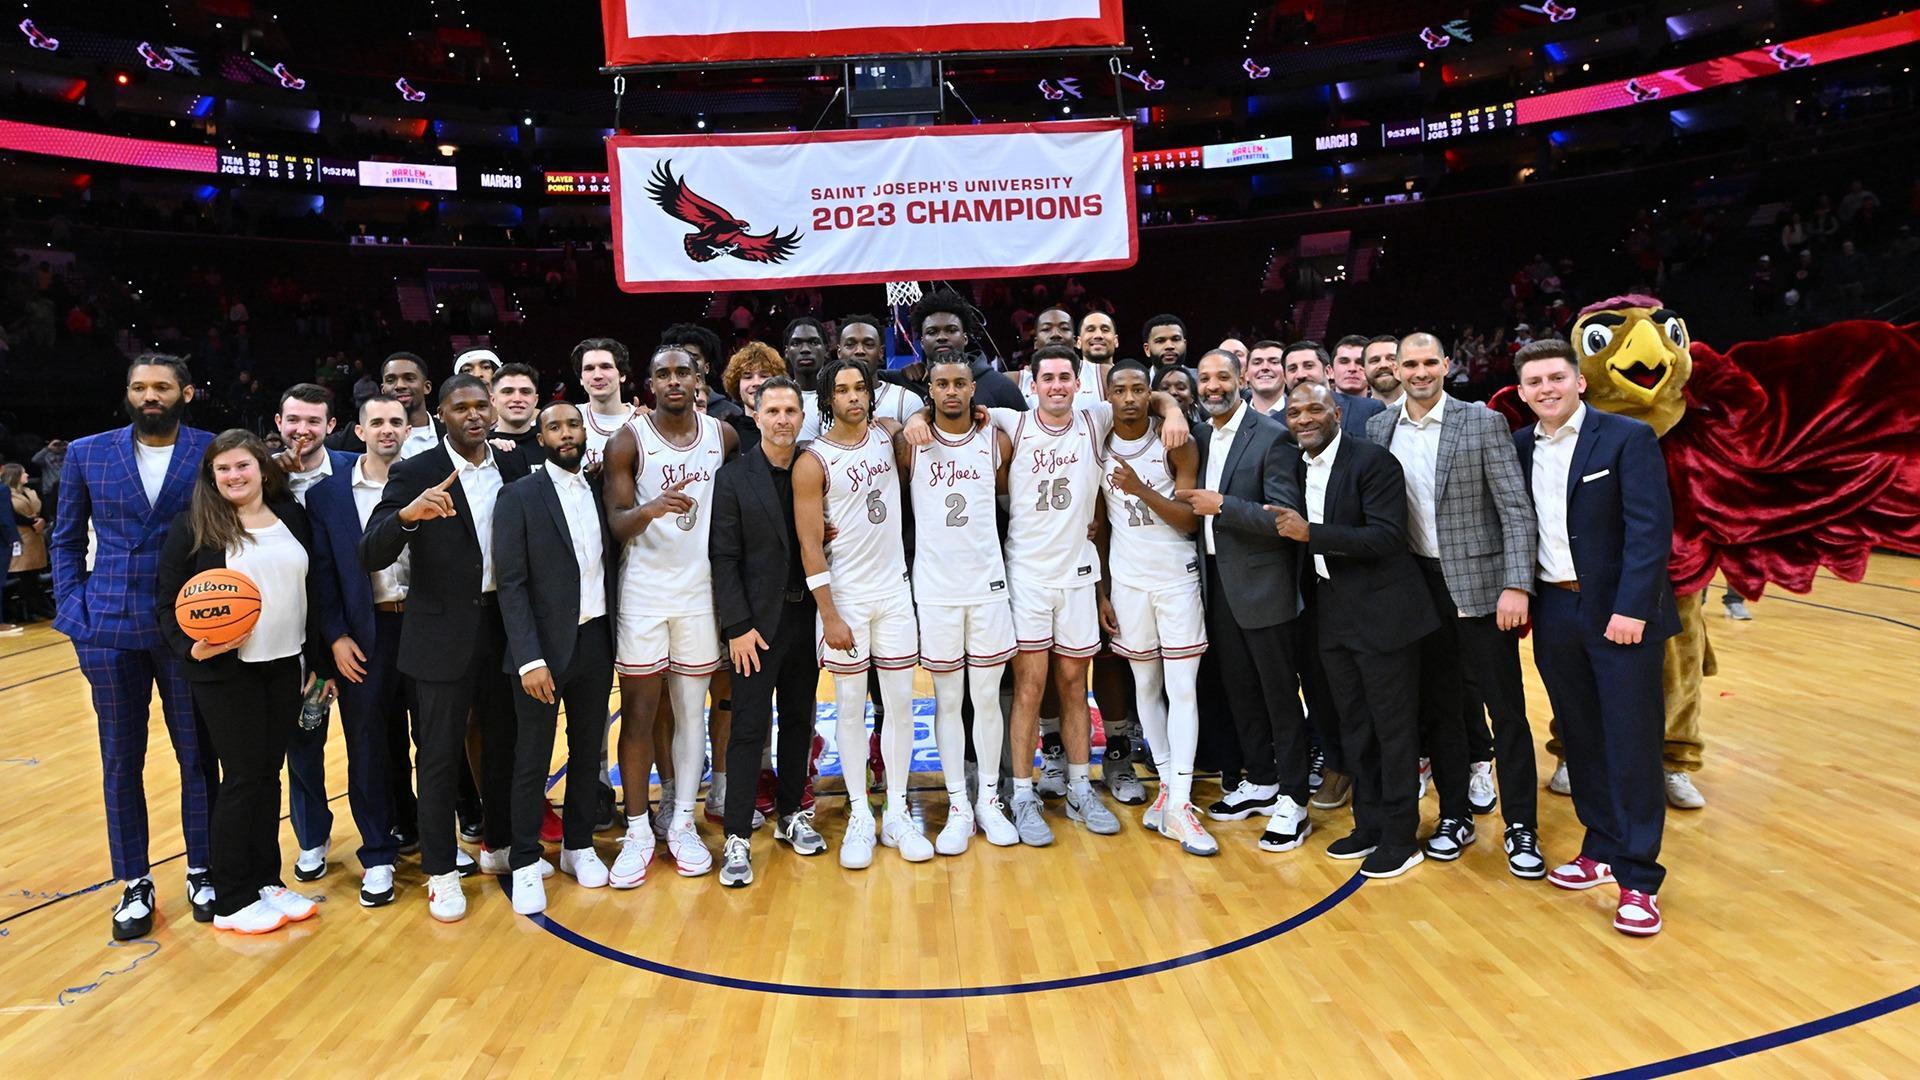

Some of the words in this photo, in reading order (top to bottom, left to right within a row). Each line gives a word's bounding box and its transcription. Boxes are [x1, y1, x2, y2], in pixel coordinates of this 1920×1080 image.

[1427, 129, 1449, 140] JOES
[1452, 127, 1462, 136] 37
[1469, 124, 1479, 133] 16
[1487, 121, 1495, 130] 5
[1506, 118, 1512, 126] 7
[1428, 121, 1447, 131] TEM
[1451, 119, 1462, 127] 39
[1469, 115, 1479, 124] 13
[1487, 113, 1494, 121] 5
[1505, 109, 1513, 117] 9
[1387, 129, 1406, 138] 9:52
[1406, 126, 1420, 136] PM
[1232, 144, 1264, 156] HARLEM
[1315, 133, 1349, 151] MARCH
[1350, 132, 1358, 146] 3
[221, 155, 243, 166] TEM
[248, 159, 261, 168] 39
[268, 161, 278, 170] 13
[287, 163, 294, 171] 5
[305, 164, 312, 172] 9
[1142, 163, 1149, 171] 11
[1154, 162, 1162, 170] 11
[1166, 161, 1175, 169] 14
[1190, 159, 1200, 167] 22
[1154, 153, 1160, 161] 3
[1166, 152, 1173, 160] 5
[1179, 151, 1186, 159] 11
[221, 164, 245, 175] JOES
[248, 167, 261, 176] 37
[268, 169, 279, 178] 16
[287, 171, 295, 179] 5
[306, 173, 312, 181] 7
[322, 166, 341, 176] 9:52
[341, 168, 356, 177] PM
[391, 168, 426, 178] HARLEM
[547, 175, 574, 183] PLAYER
[579, 175, 584, 183] 1
[591, 175, 597, 183] 3
[480, 173, 514, 188] MARCH
[514, 175, 522, 189] 3
[547, 184, 574, 192] POINTS
[577, 184, 586, 192] 19
[589, 184, 599, 192] 10
[811, 185, 866, 200] SAINT
[873, 180, 958, 197] JOSEPH'S
[965, 176, 1073, 193] UNIVERSITY
[812, 202, 896, 231] 2023
[906, 193, 1103, 225] CHAMPIONS
[1031, 448, 1048, 474] St
[1048, 448, 1079, 474] Joe's
[660, 464, 678, 491] St
[846, 465, 864, 493] St
[860, 457, 892, 487] Joe's
[929, 461, 946, 487] St
[946, 460, 981, 487] Joe's
[1035, 477, 1073, 511] 15
[675, 496, 699, 531] 3
[944, 492, 969, 528] 2
[1124, 499, 1155, 527] 11
[183, 581, 239, 598] Wilson
[190, 605, 231, 620] NCAA
